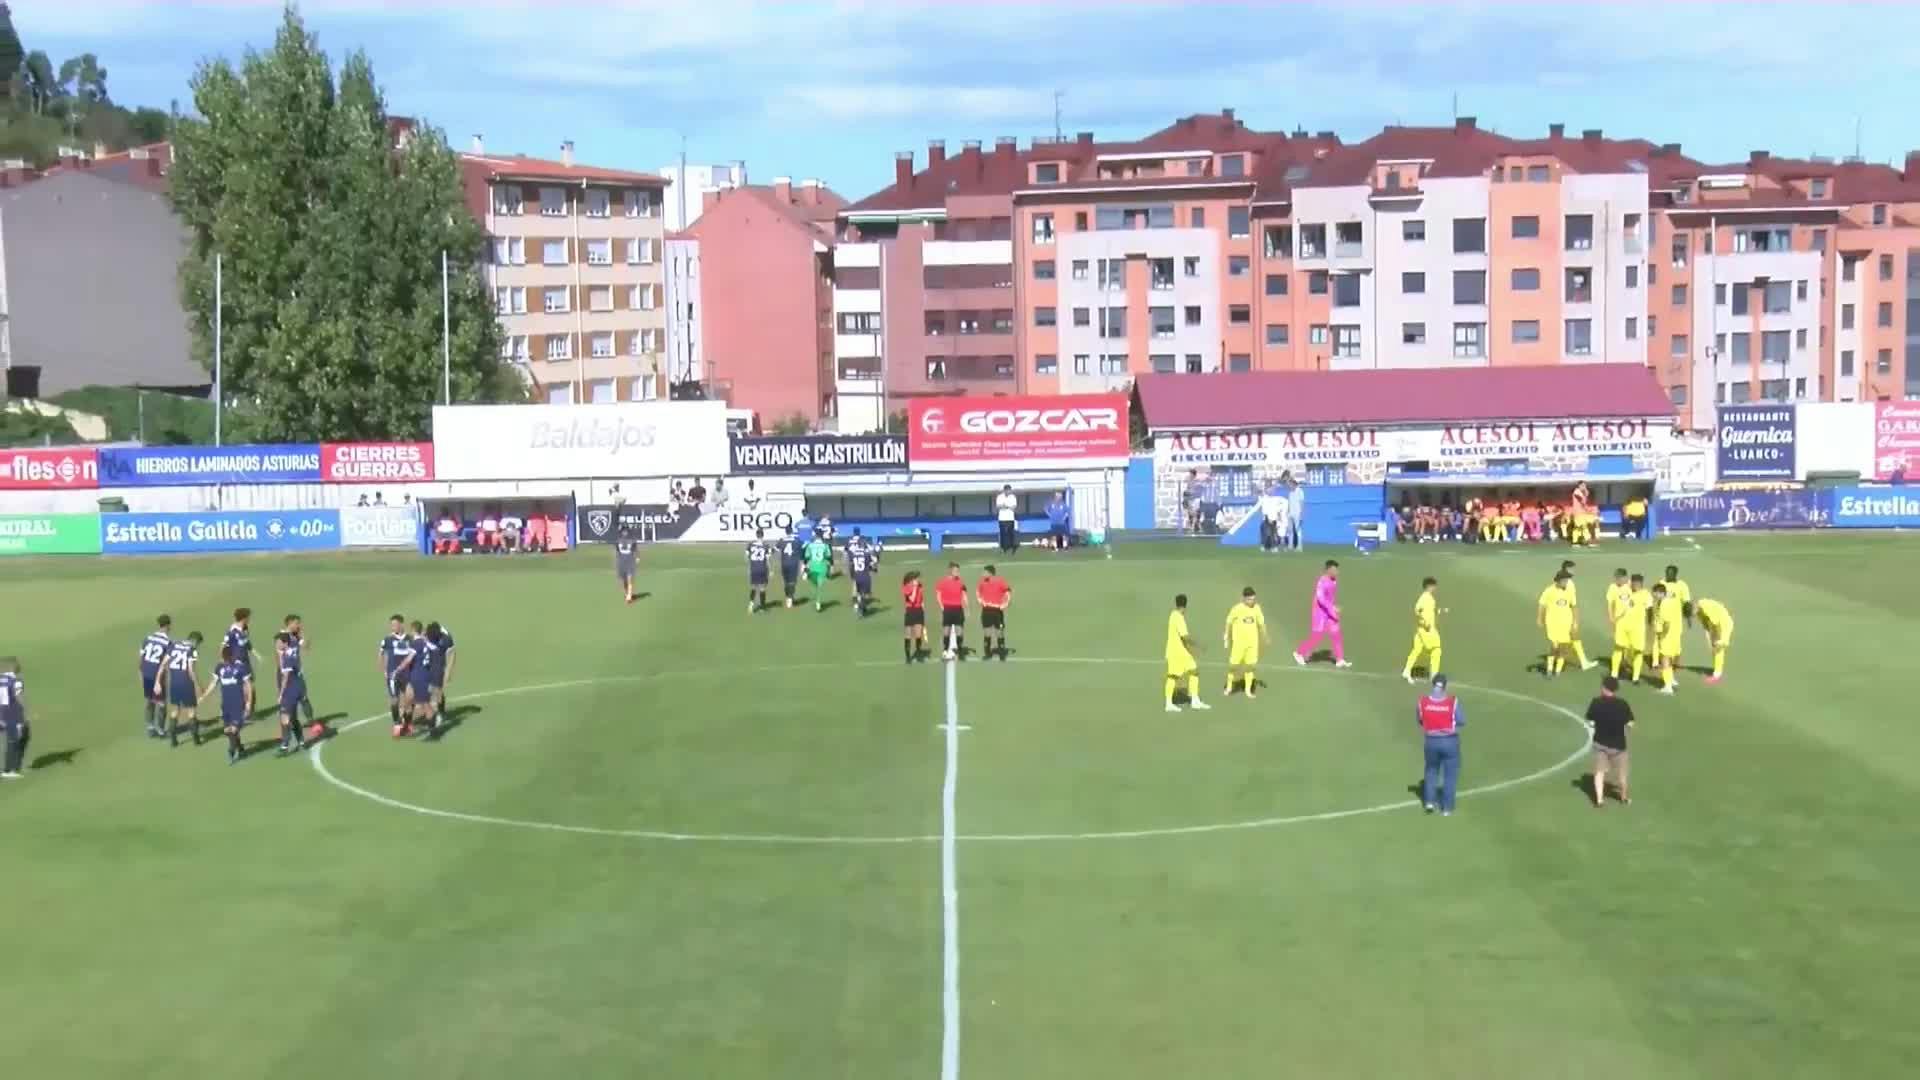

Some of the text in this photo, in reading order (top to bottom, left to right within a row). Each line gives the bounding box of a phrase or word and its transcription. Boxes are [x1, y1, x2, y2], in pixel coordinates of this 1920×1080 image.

[960, 408, 1120, 433] GOZCAR
[1723, 412, 1790, 422] RESTAURANTE
[530, 417, 657, 455] Baldajos
[1282, 429, 1380, 448] ACESOL
[1440, 424, 1540, 445] ACESOL
[1551, 419, 1653, 441] ACESOL
[1721, 425, 1793, 448] Guernica
[1171, 431, 1268, 450] ACESOL
[336, 447, 421, 461] CIERRES
[735, 439, 905, 466] VENTANAS CASTRILLÓN
[136, 454, 319, 474] HIERROS LAMINADOS ASTURIAS
[331, 462, 426, 477] GUERRAS
[1839, 496, 1920, 516] Estrella
[105, 521, 182, 543] Estrella
[187, 519, 258, 541] Galicia
[720, 512, 793, 532] SIRGO
[750, 549, 766, 561] 23
[784, 542, 793, 556] 4
[853, 557, 866, 572] 15
[144, 643, 164, 663] 12
[169, 650, 188, 671] 21
